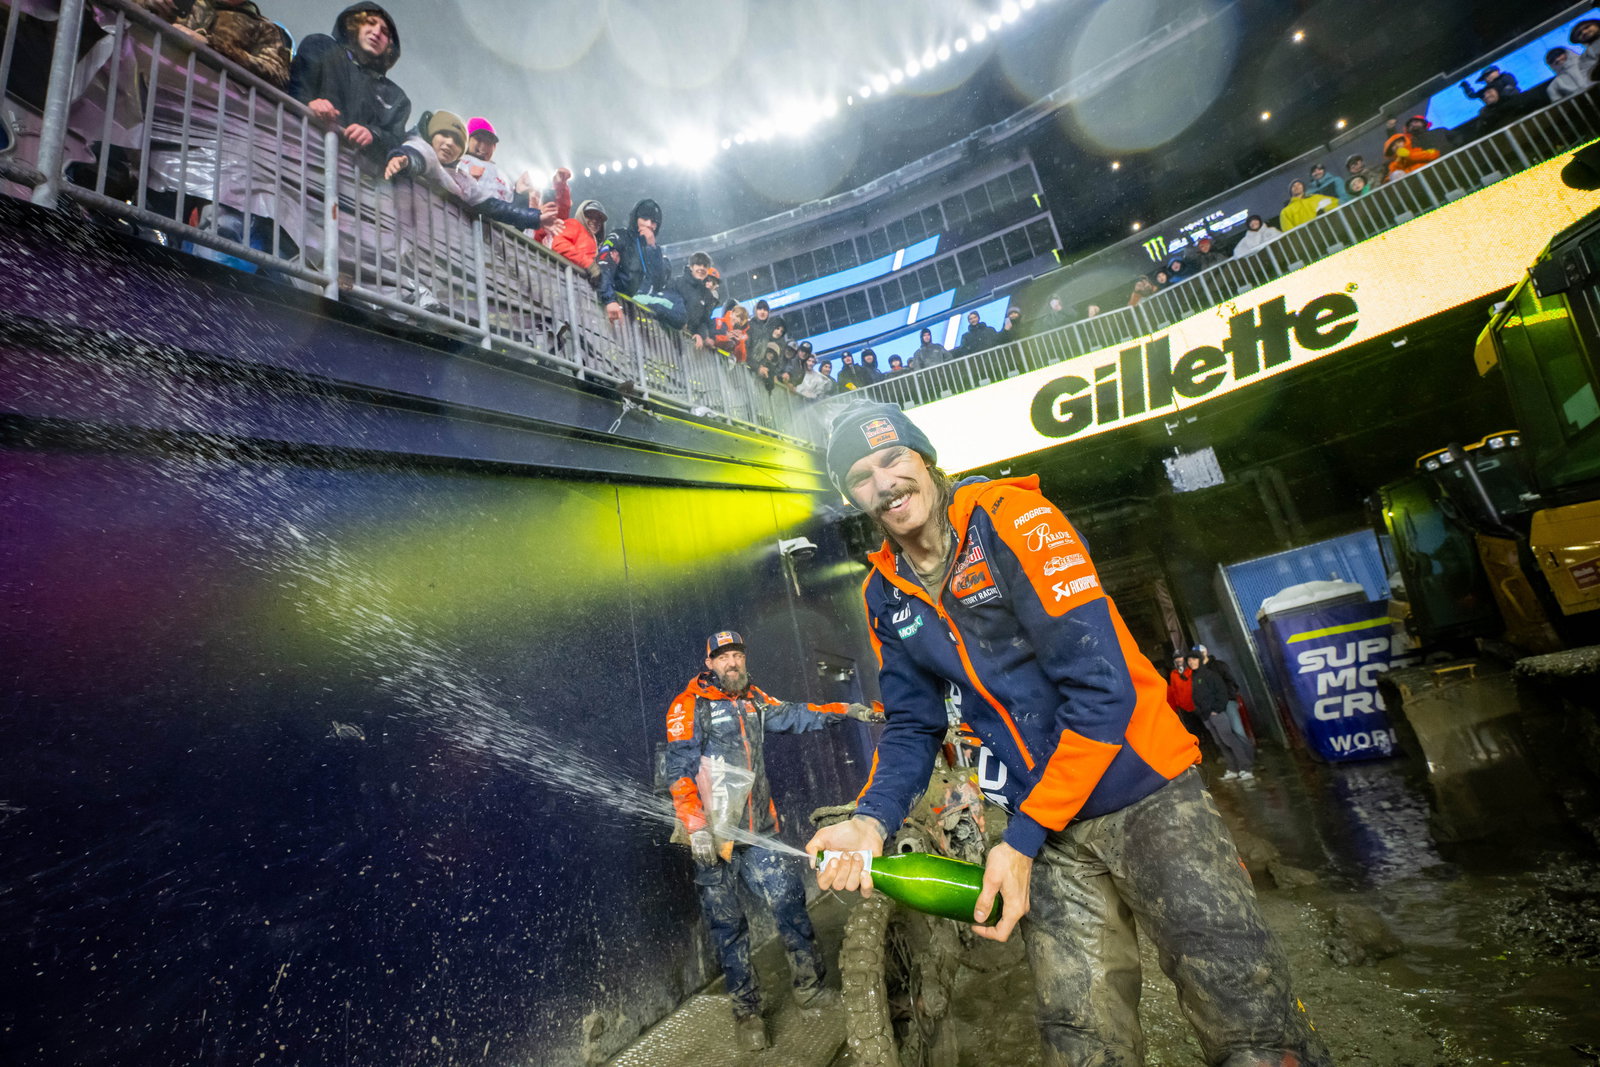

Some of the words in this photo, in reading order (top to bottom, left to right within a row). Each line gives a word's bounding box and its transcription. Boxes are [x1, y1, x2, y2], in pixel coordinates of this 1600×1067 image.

[1030, 292, 1359, 439] Gillette
[956, 571, 986, 593] KTM
[959, 596, 978, 606] CTORY
[898, 615, 922, 638] MOTOX
